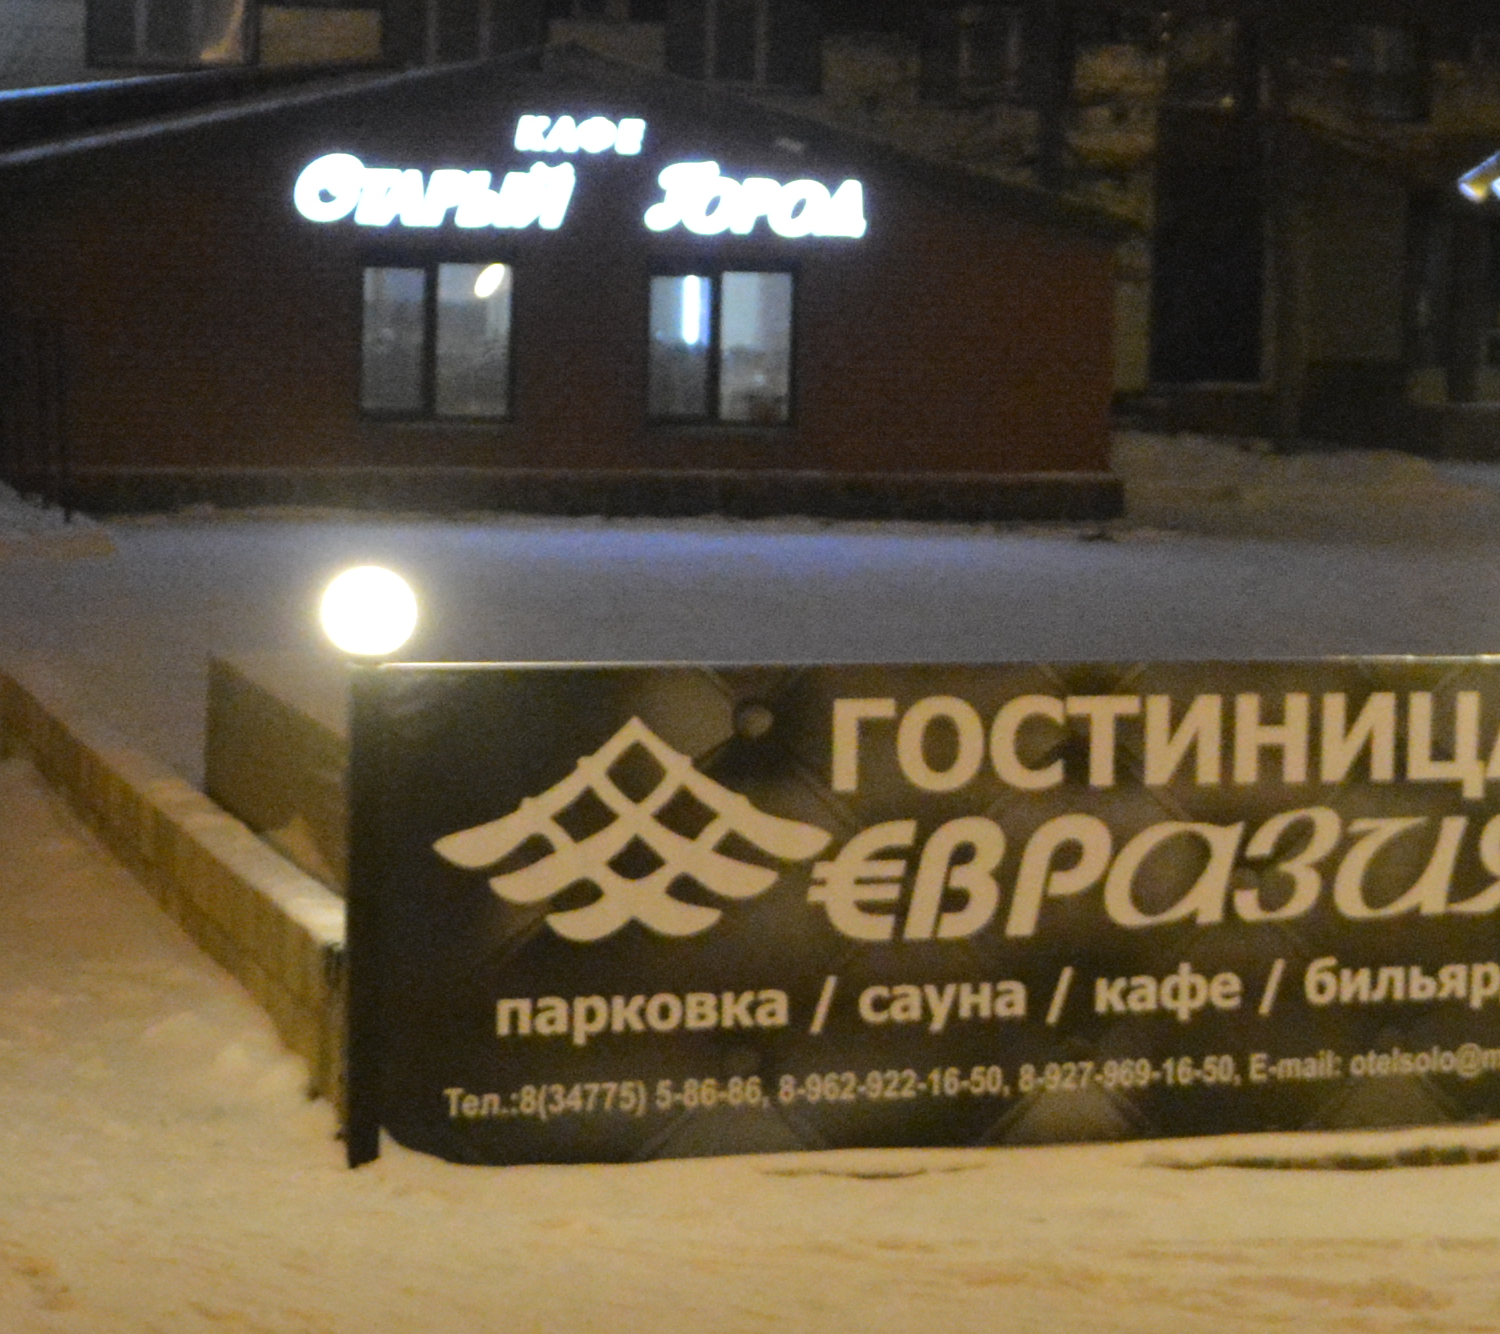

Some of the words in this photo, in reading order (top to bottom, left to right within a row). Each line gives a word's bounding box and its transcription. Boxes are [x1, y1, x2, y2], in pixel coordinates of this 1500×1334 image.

[496, 987, 789, 1046] парковка
[857, 977, 1027, 1033] сауна
[1094, 961, 1243, 1022] кафе
